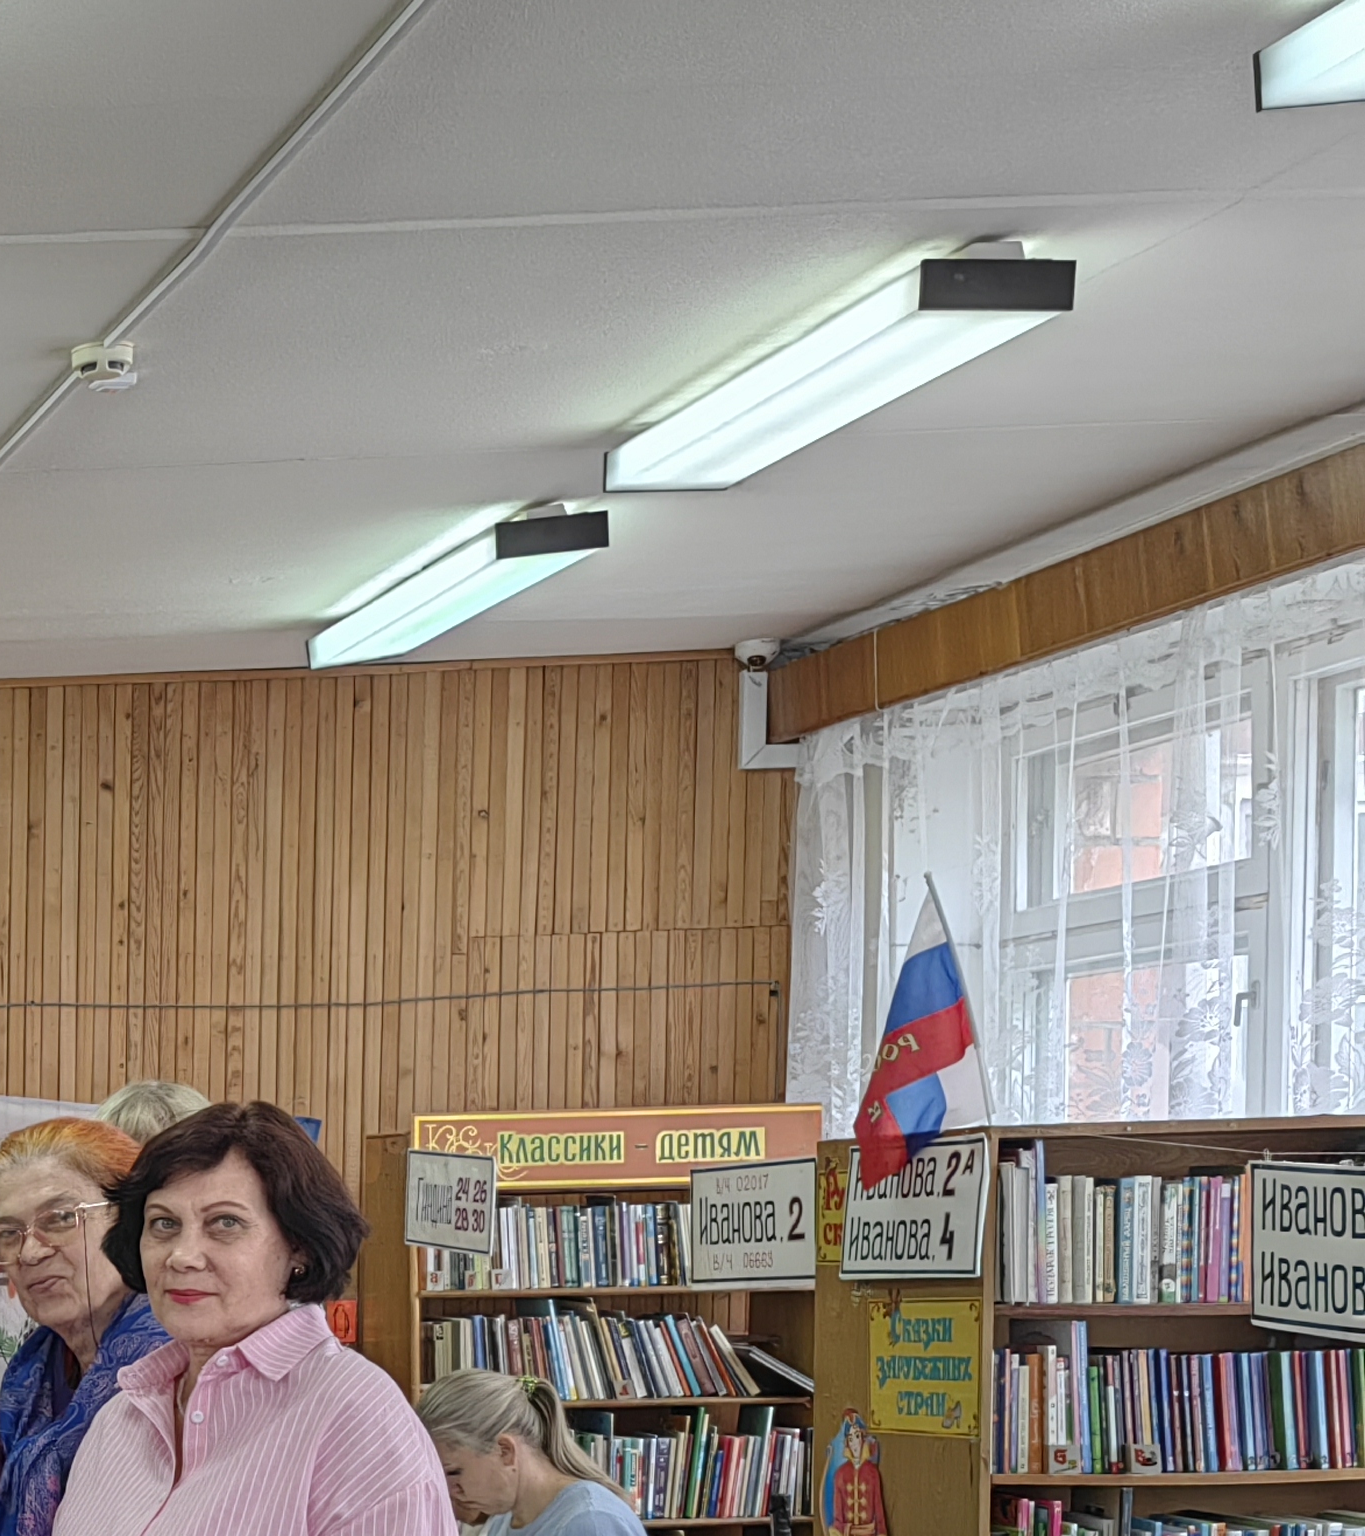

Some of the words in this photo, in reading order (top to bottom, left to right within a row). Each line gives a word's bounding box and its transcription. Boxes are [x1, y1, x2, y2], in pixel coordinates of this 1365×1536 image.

[499, 1133, 623, 1164] Классики
[657, 1129, 762, 1163] детям
[455, 1177, 470, 1203] 24
[473, 1180, 487, 1204] 26
[455, 1207, 469, 1232] 28
[472, 1208, 486, 1233] 30
[787, 1196, 806, 1242] 2
[939, 1211, 956, 1261] 4
